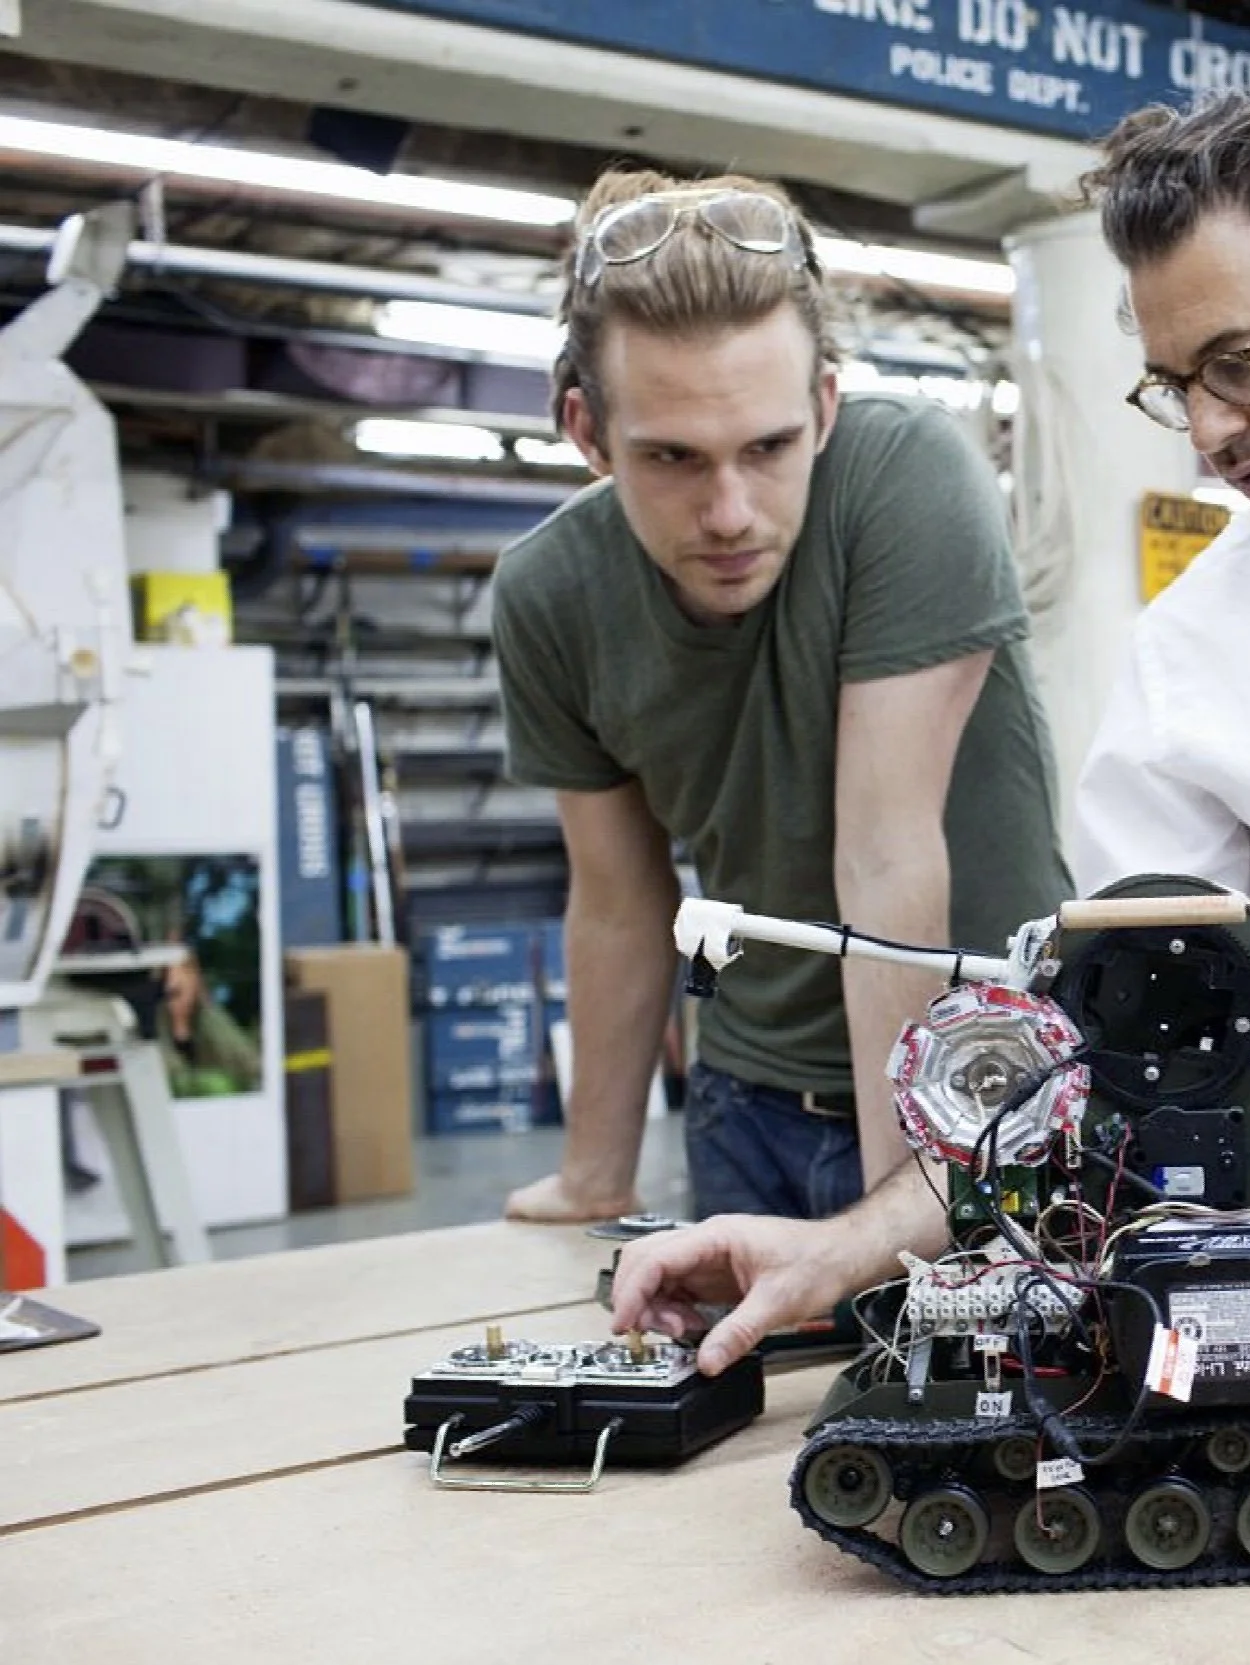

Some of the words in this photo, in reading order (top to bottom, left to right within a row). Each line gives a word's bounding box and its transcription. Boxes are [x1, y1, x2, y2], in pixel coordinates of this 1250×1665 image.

[958, 0, 1028, 50] DO
[1052, 6, 1145, 78] NOT
[890, 43, 994, 95] POLICE
[1007, 67, 1091, 114] DEPT.
[980, 1399, 1004, 1414] ON
